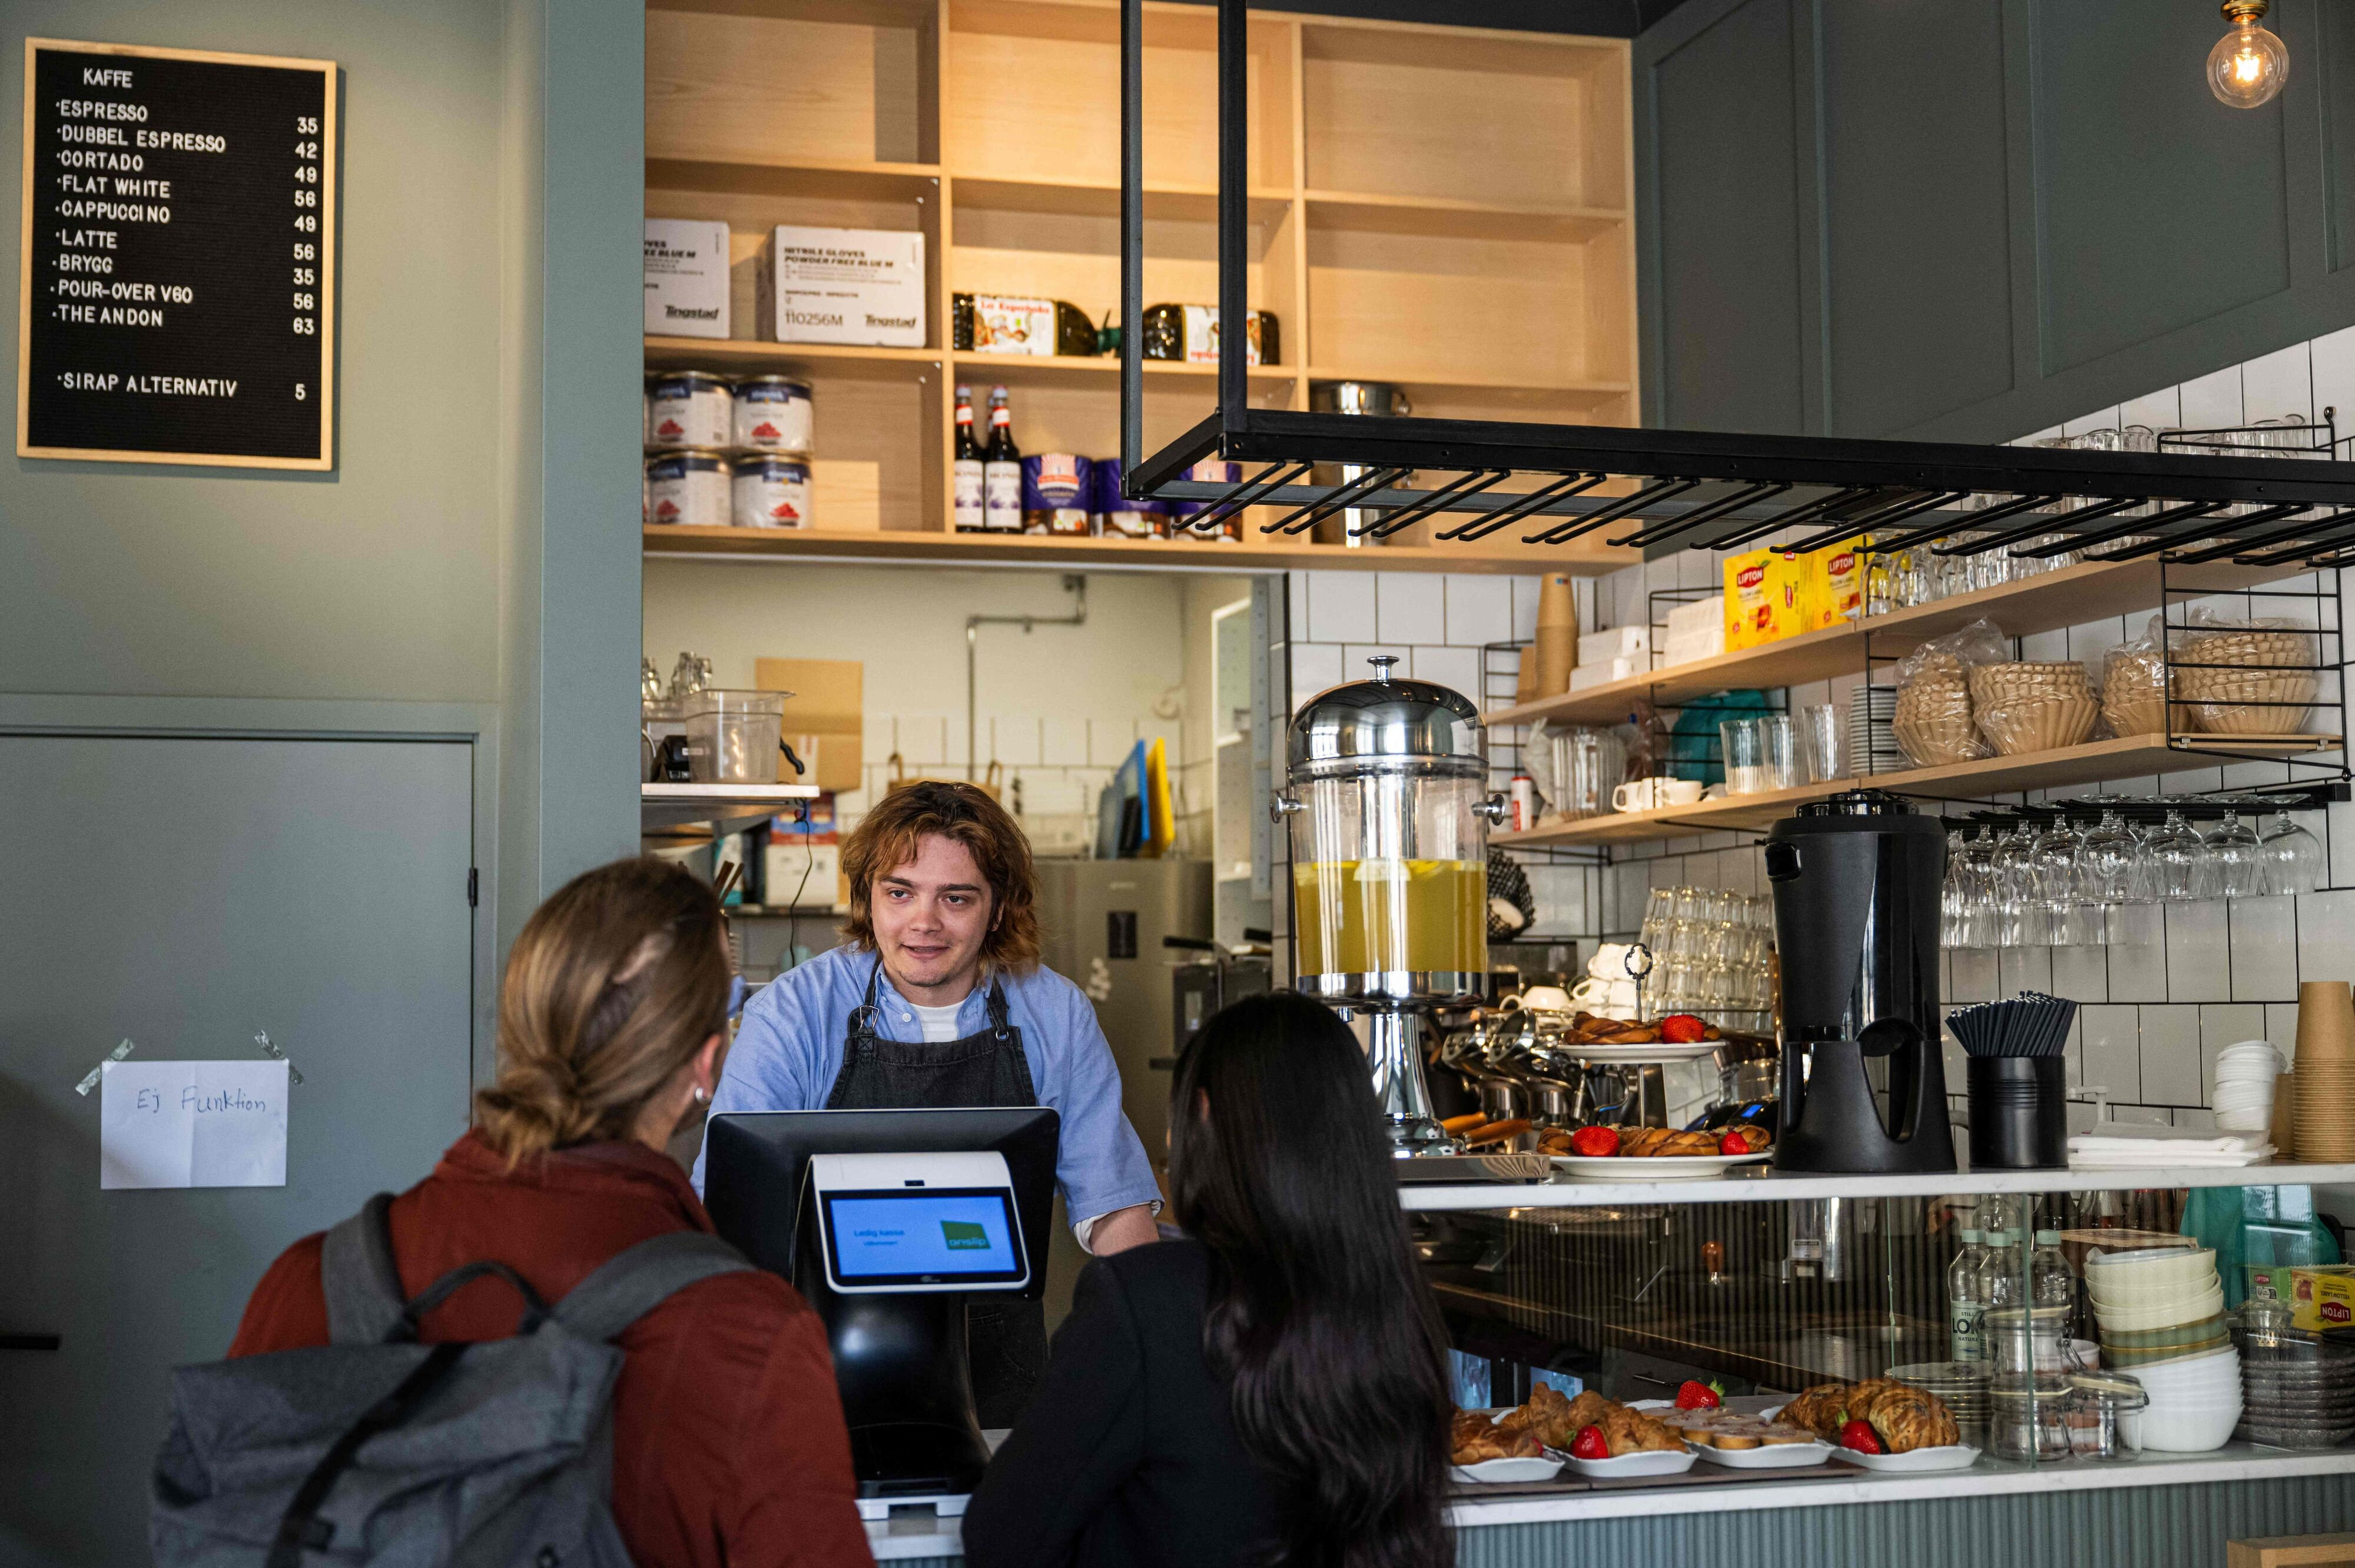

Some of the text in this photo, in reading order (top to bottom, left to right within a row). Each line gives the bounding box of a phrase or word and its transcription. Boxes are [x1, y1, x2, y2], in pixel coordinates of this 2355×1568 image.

[83, 68, 133, 88] KAFFE
[60, 99, 318, 135] ESPRESSO 35
[62, 124, 318, 160] DUBBEL ESPRESSO 42
[61, 150, 318, 184] CORTADO 49
[62, 174, 317, 208] FLAT WHITE 56
[61, 200, 317, 232] CAPPUCCINO 49
[62, 228, 316, 261] LATTE 56
[826, 249, 865, 257] GLOVES
[59, 253, 315, 285] BRYGG 35
[784, 255, 829, 264] POWDER
[58, 278, 314, 310] POUR-OVER V60 56
[58, 304, 315, 335] THE ANDON 63
[666, 305, 719, 320] Tingstad
[865, 313, 917, 328] Tingstad
[63, 371, 306, 401] SIRAP ALTERNATIV 5
[1737, 568, 1763, 585] LIPTON
[1829, 555, 1854, 573] LIPTON
[137, 1085, 266, 1114] Ej Funktion
[949, 1237, 987, 1247] onslip
[2322, 1306, 2350, 1319] LIPTON
